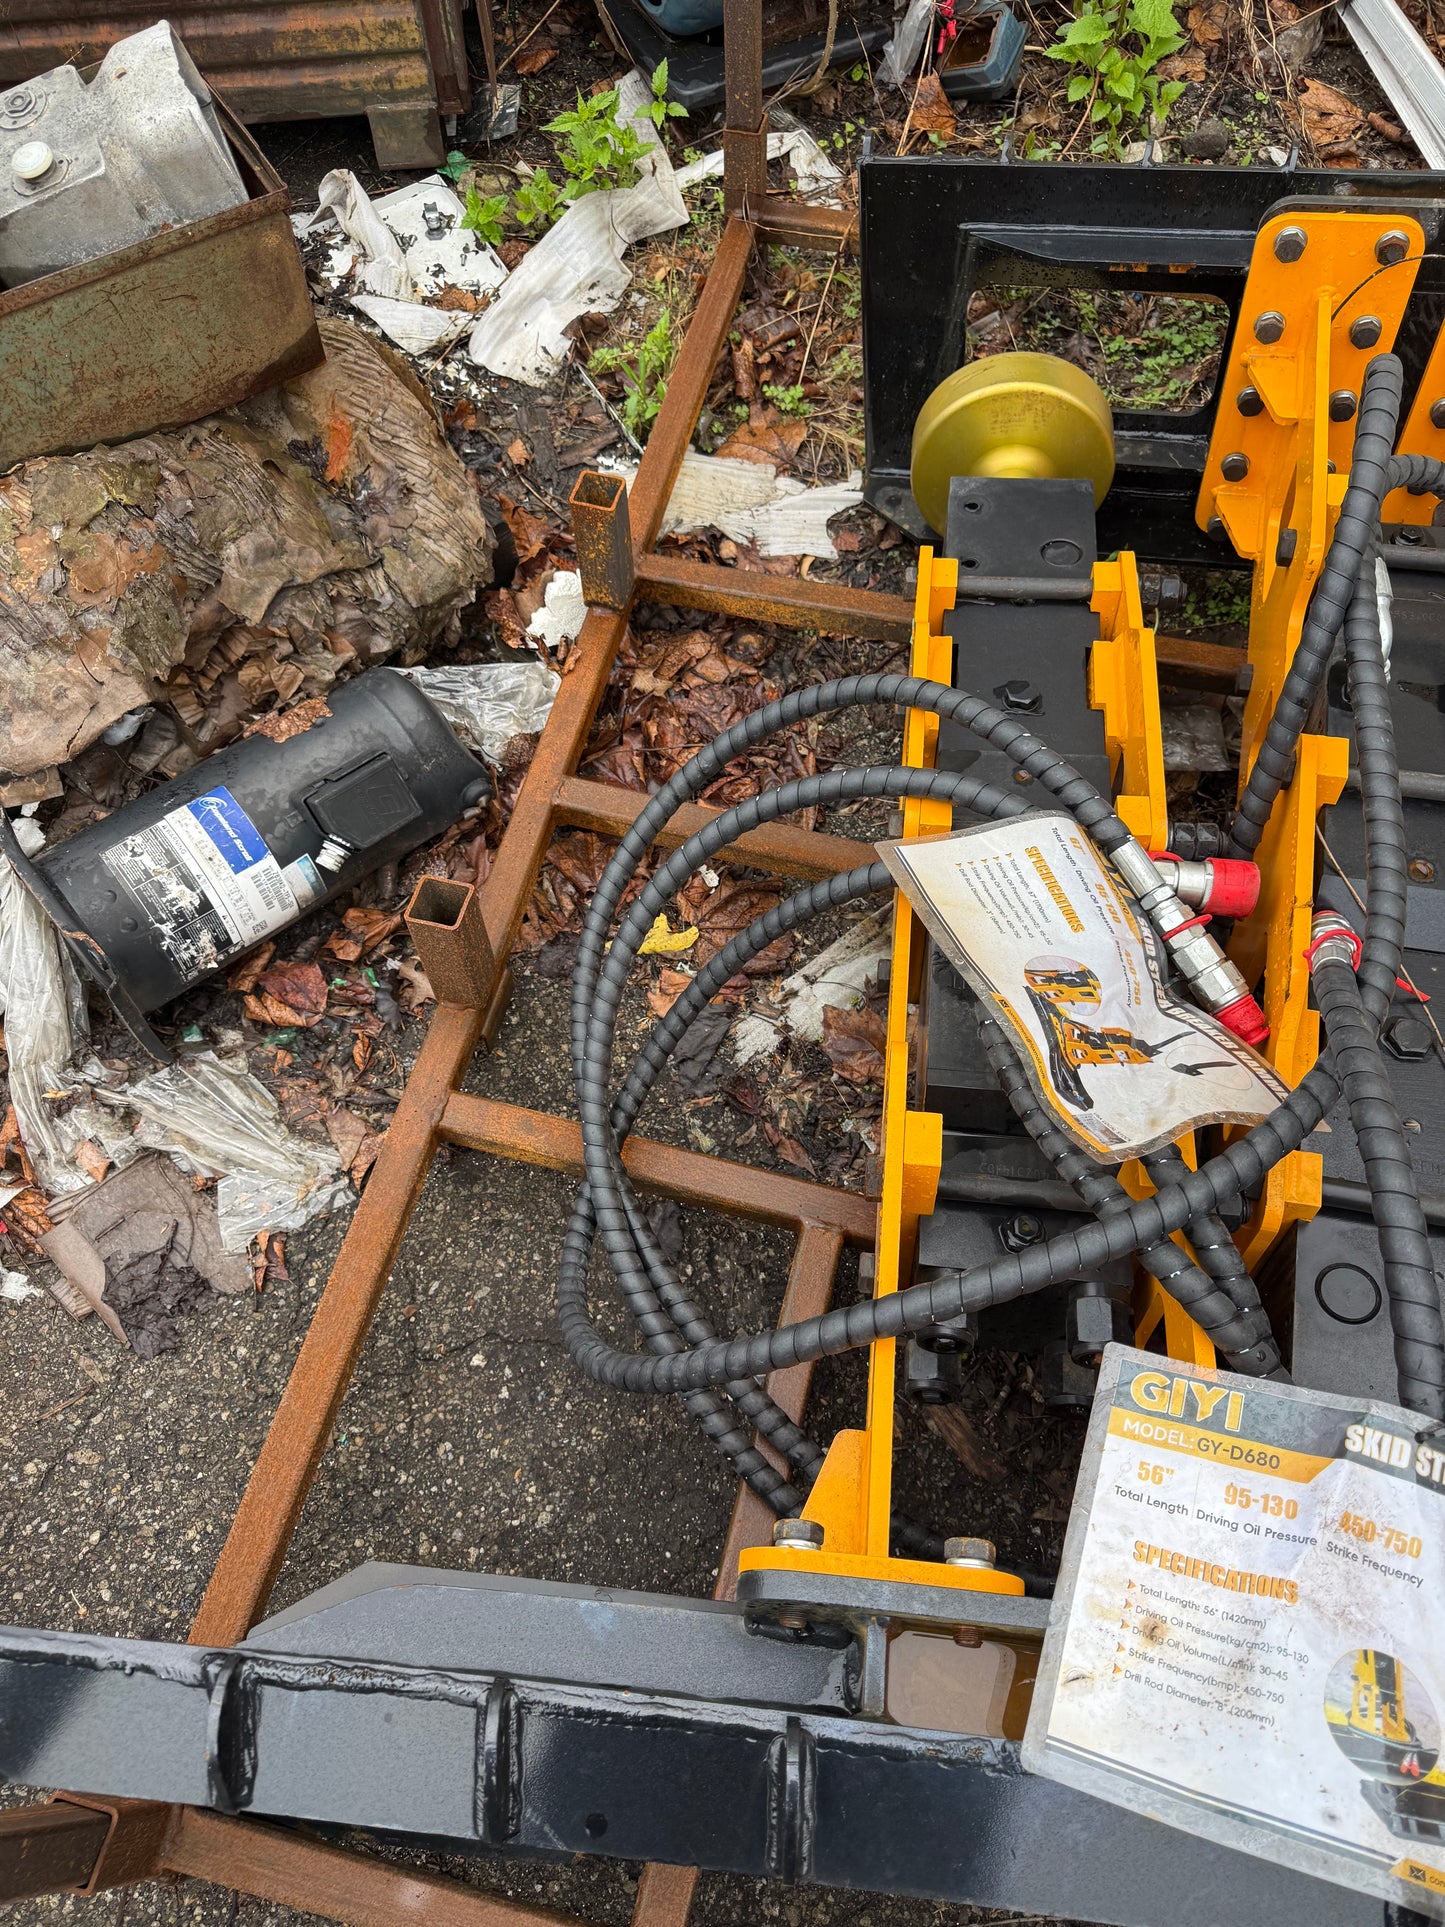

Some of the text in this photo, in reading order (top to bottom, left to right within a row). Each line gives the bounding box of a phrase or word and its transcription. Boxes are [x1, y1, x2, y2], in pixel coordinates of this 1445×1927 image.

[233, 838, 254, 862] Scroll
[996, 862, 1008, 879] Driving
[1009, 858, 1020, 875] Total
[1050, 826, 1077, 867] Total Length
[971, 866, 982, 880] Strike
[984, 864, 996, 881] Driving
[1025, 845, 1085, 934] SPECIFICATIONS
[1075, 869, 1115, 935] Driving Oil Pressure
[1094, 882, 1122, 924] 95-130
[1136, 914, 1289, 1102] SKID STEER BREAKER HAMME
[1130, 1371, 1245, 1432] GIYI
[1123, 1418, 1281, 1470] MODEL: GY-D680
[1344, 1424, 1445, 1485] SKID ST
[1137, 1460, 1176, 1486] 56"
[1114, 1485, 1189, 1517] Total Length
[1224, 1484, 1299, 1521] 95-130
[1196, 1509, 1318, 1547] Driving Oil Pressure
[1338, 1510, 1422, 1559] 450-750
[1132, 1539, 1299, 1605] SPECIFICATIONS
[1326, 1540, 1424, 1588] Strike Frequency
[1139, 1583, 1267, 1630] Total Length: 56" (1420mm)
[1131, 1625, 1289, 1682] Driving Oil Volume(L/min): 30-45
[1135, 1605, 1310, 1664] Driving Oil Pressure(kg/cm2): 95-130
[1124, 1669, 1142, 1684] Drill
[1144, 1675, 1163, 1692] Rod
[1166, 1684, 1214, 1709] Diameter:
[1229, 1706, 1275, 1727] (200mm)
[1128, 1647, 1285, 1705] Strike Frequency(bmp): 450-750
